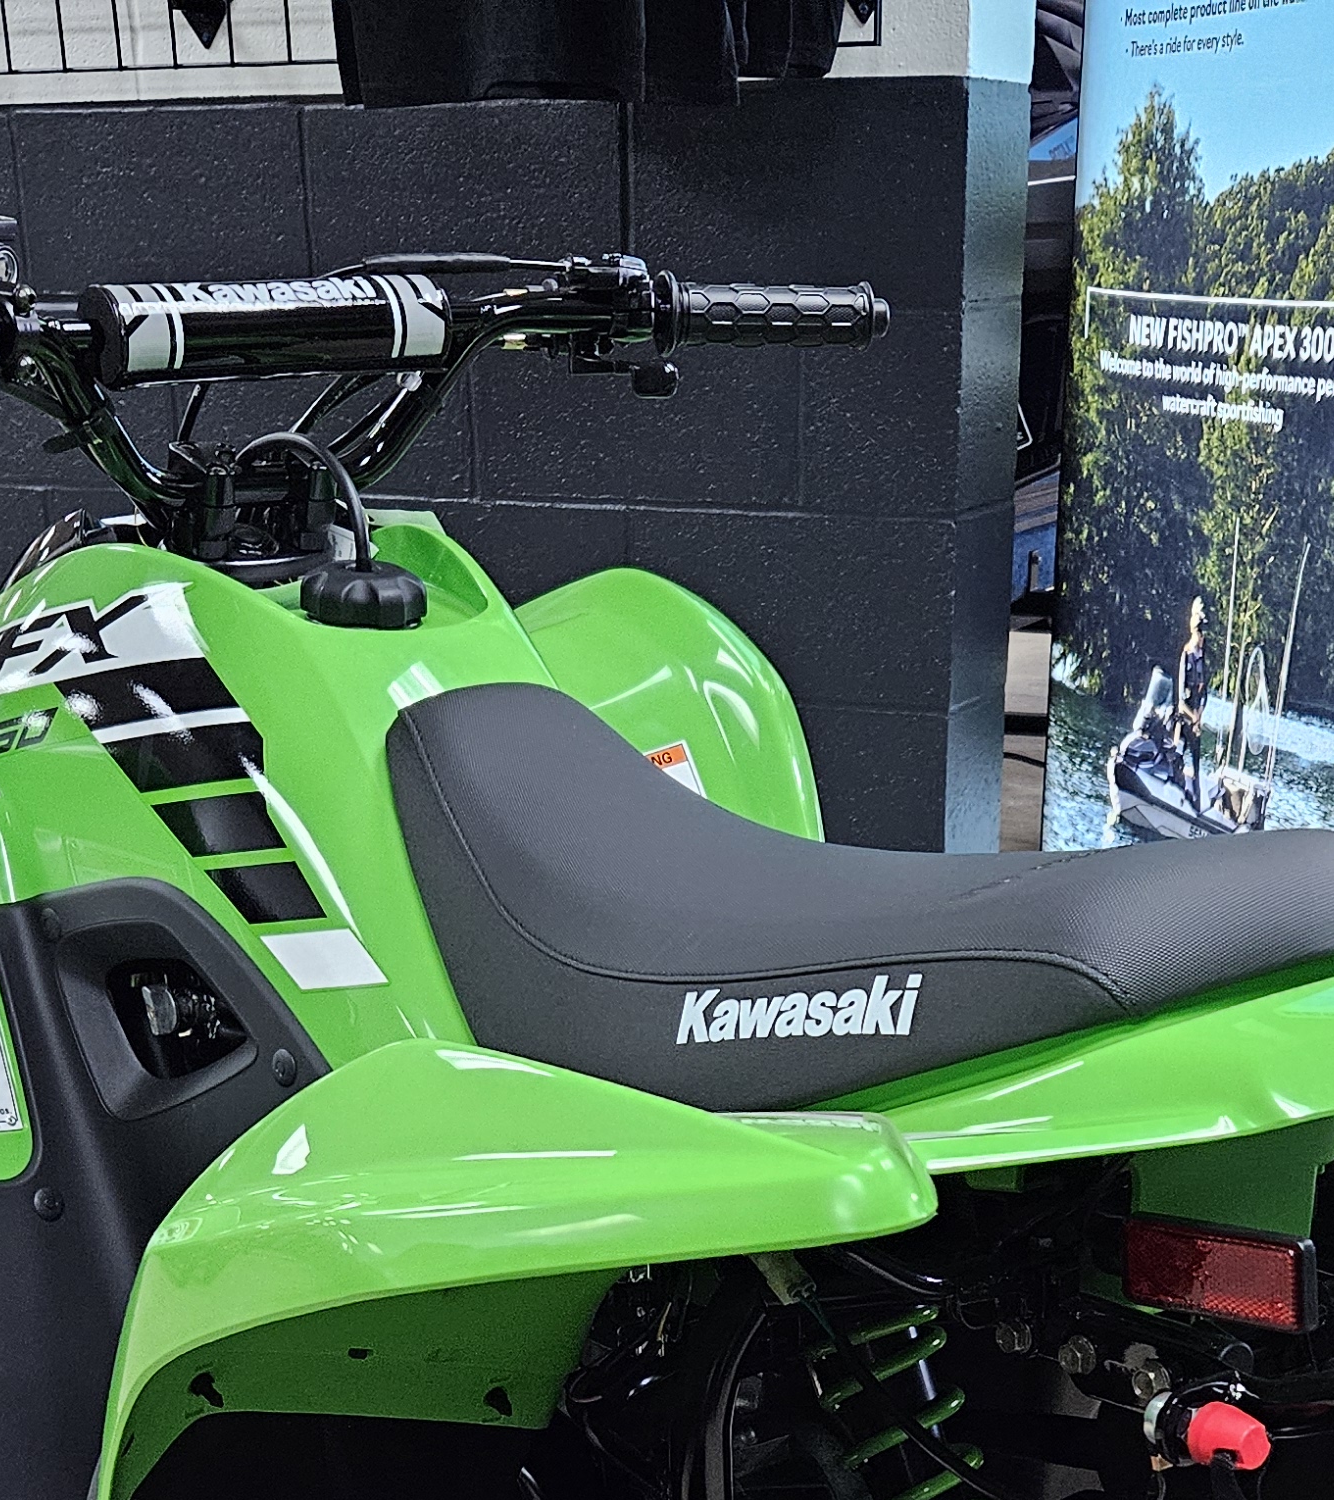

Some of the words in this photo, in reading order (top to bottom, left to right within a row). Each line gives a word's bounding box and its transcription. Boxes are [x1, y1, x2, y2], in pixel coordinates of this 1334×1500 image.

[1124, 9, 1146, 26] Most
[1147, 5, 1188, 28] complete
[1190, 1, 1227, 25] product
[1130, 39, 1158, 57] There's
[1165, 37, 1182, 54] ride
[1183, 36, 1196, 53] for
[1197, 36, 1220, 54] every
[1221, 29, 1244, 53] style.
[170, 276, 379, 309] Kawasaki
[1129, 314, 1167, 348] NEW
[1249, 322, 1299, 360] APEX
[1100, 350, 1142, 377] Welcome
[1143, 361, 1153, 377] to
[1154, 358, 1172, 380] the
[1173, 361, 1201, 385] world
[1202, 364, 1216, 386] of
[1217, 365, 1315, 398] high-performance
[1162, 394, 1217, 417] watercraft
[1218, 398, 1284, 431] sportfishing
[675, 973, 923, 1046] Kawasaki
